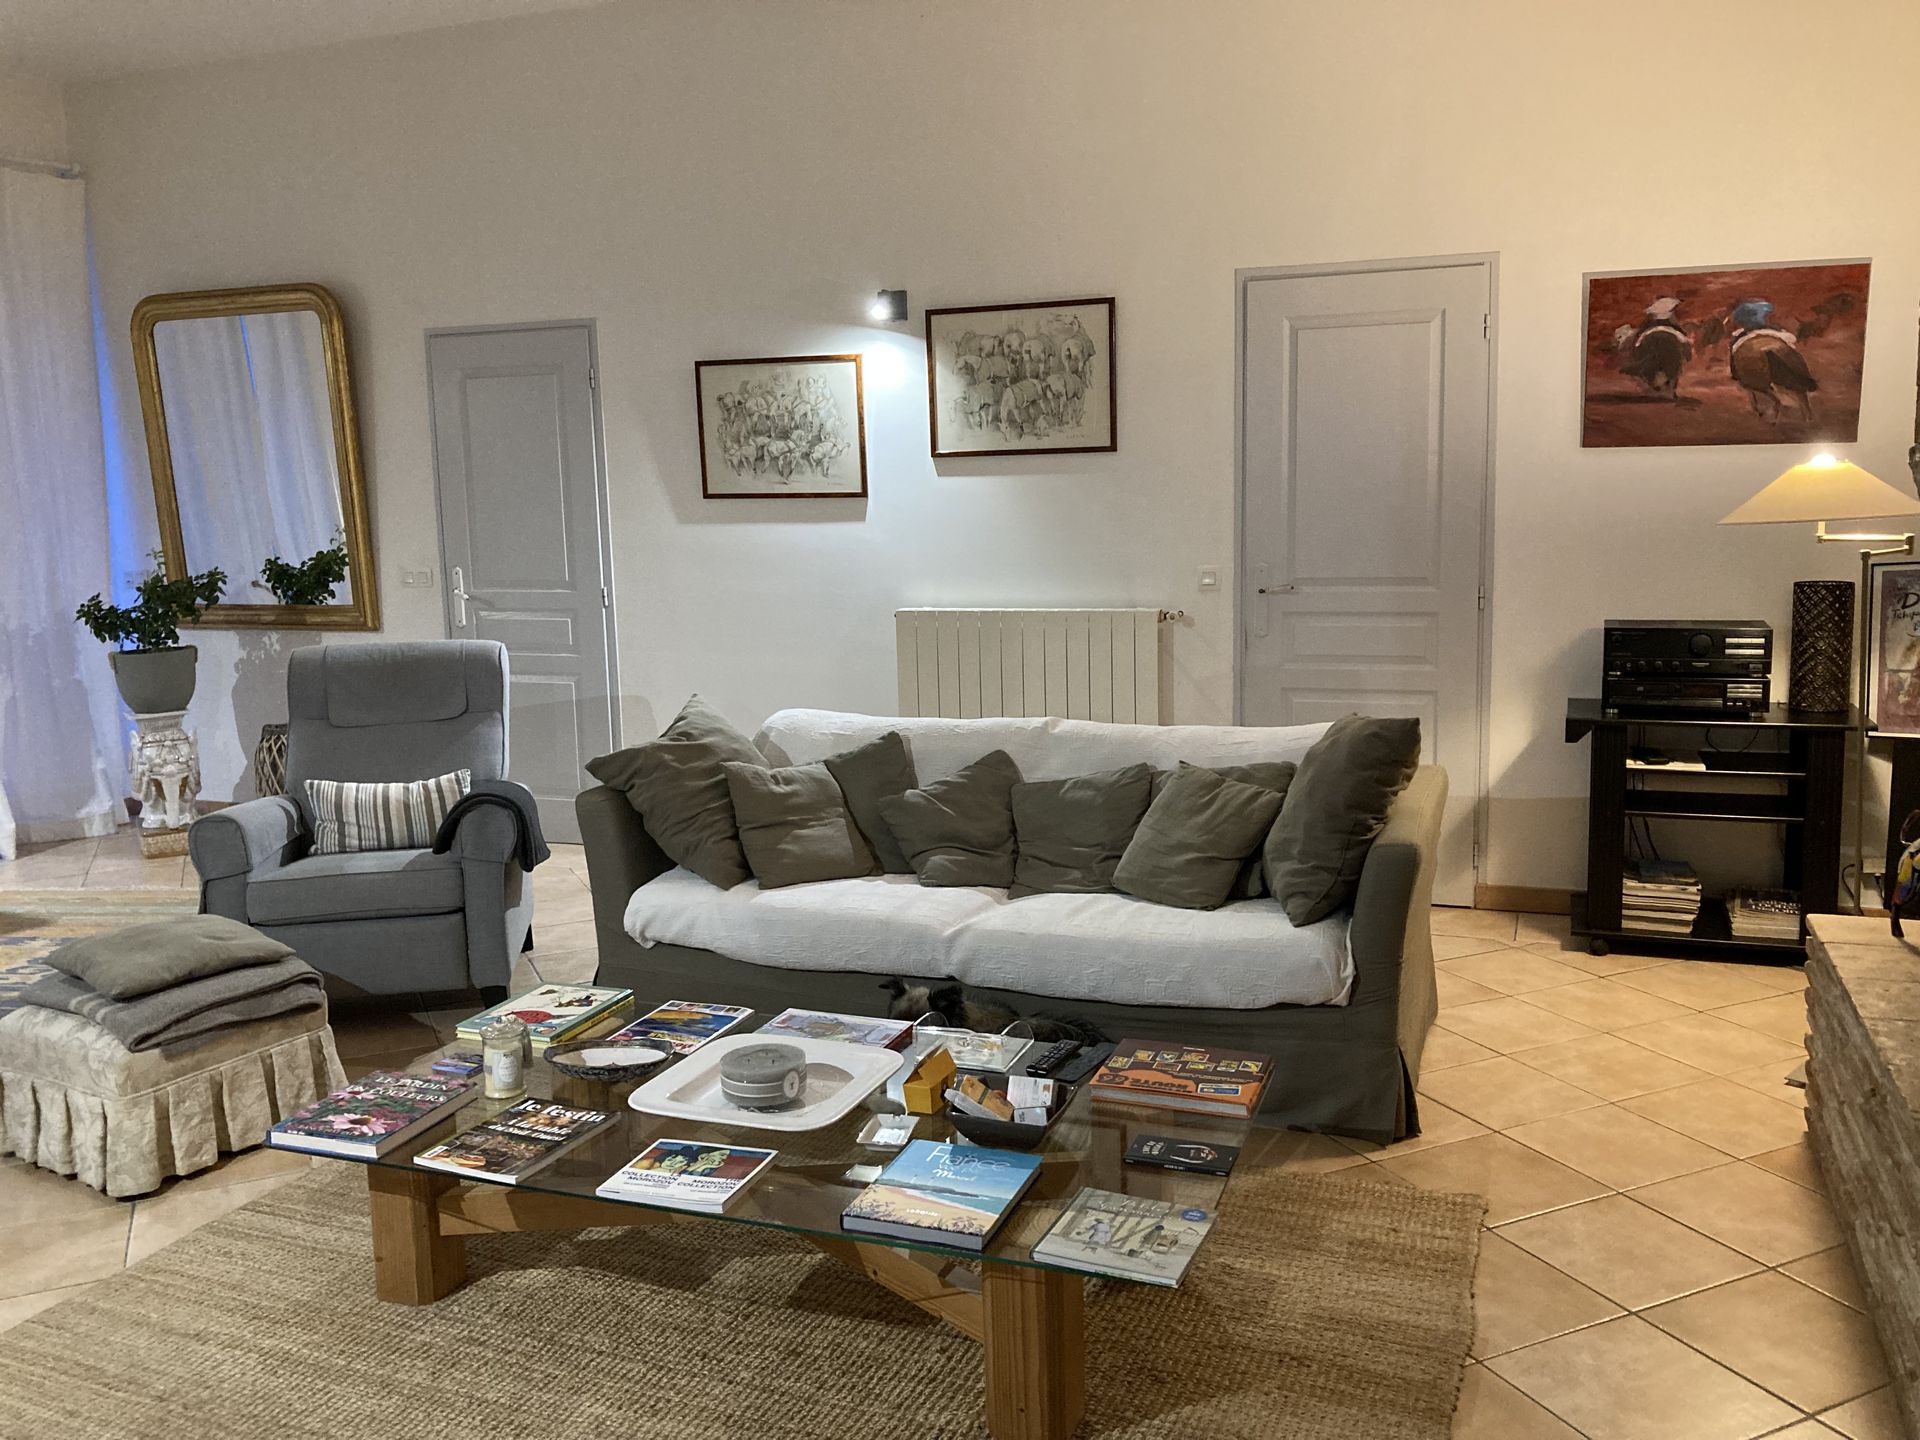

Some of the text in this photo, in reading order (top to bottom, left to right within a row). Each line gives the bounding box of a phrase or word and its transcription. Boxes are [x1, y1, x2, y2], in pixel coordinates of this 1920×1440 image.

[375, 1076, 449, 1091] LE JARDIN
[1130, 1078, 1190, 1091] ROUTE
[367, 1087, 448, 1102] COULEURS
[515, 1100, 606, 1123] le festin
[926, 1145, 1011, 1171] France
[621, 1170, 679, 1181] COLLECTION
[627, 1176, 674, 1185] MOROZOV
[677, 1181, 736, 1190] COLLECTION
[692, 1179, 742, 1187] MOROZOV
